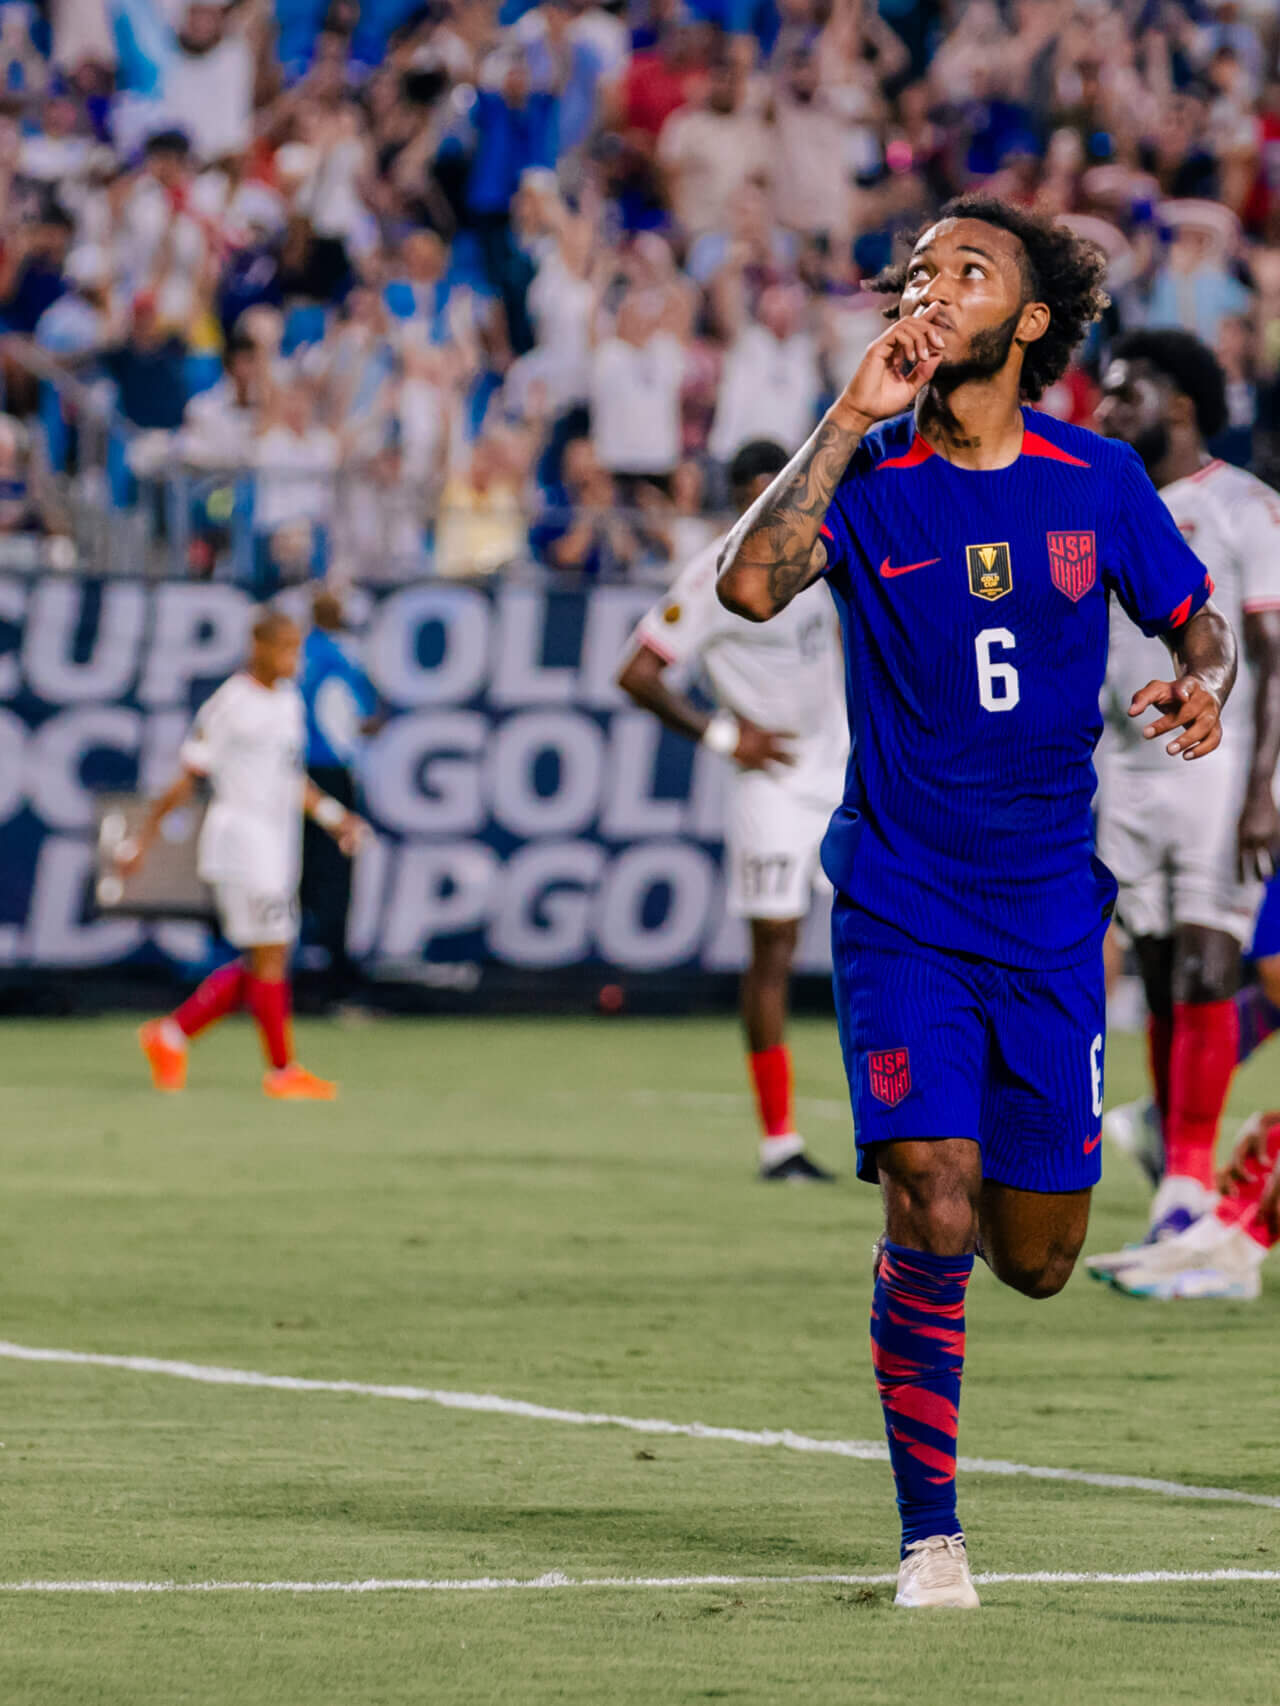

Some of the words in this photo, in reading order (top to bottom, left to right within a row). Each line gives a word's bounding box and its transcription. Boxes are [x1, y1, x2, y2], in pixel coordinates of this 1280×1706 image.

[1051, 535, 1091, 561] USA
[975, 628, 1020, 712] 6
[872, 1052, 906, 1075] USA
